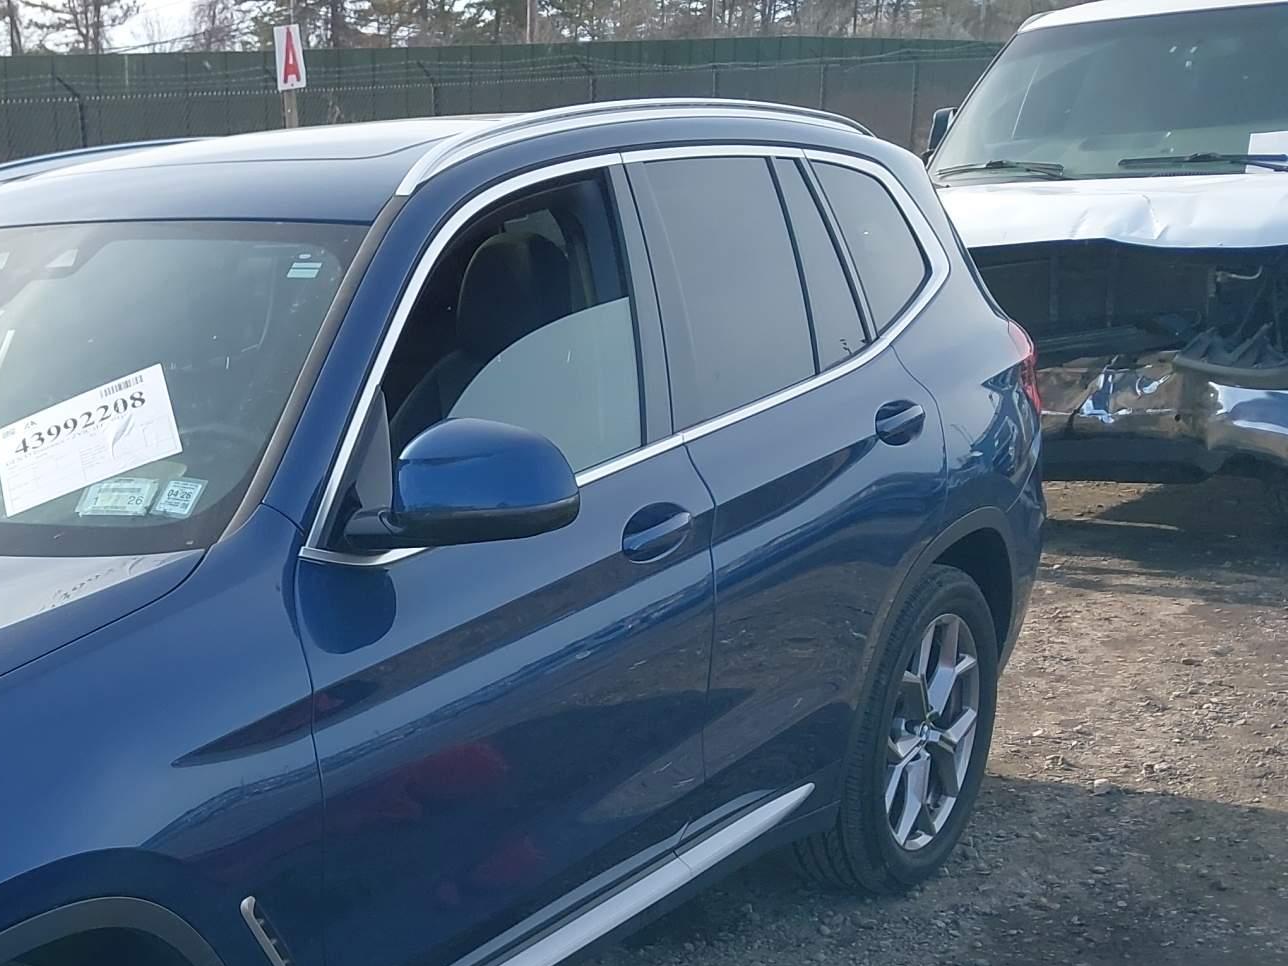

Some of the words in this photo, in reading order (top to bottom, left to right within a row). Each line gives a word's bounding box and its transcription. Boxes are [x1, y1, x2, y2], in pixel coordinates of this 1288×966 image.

[283, 26, 302, 84] A
[14, 391, 146, 454] 43992208
[127, 495, 145, 506] 26
